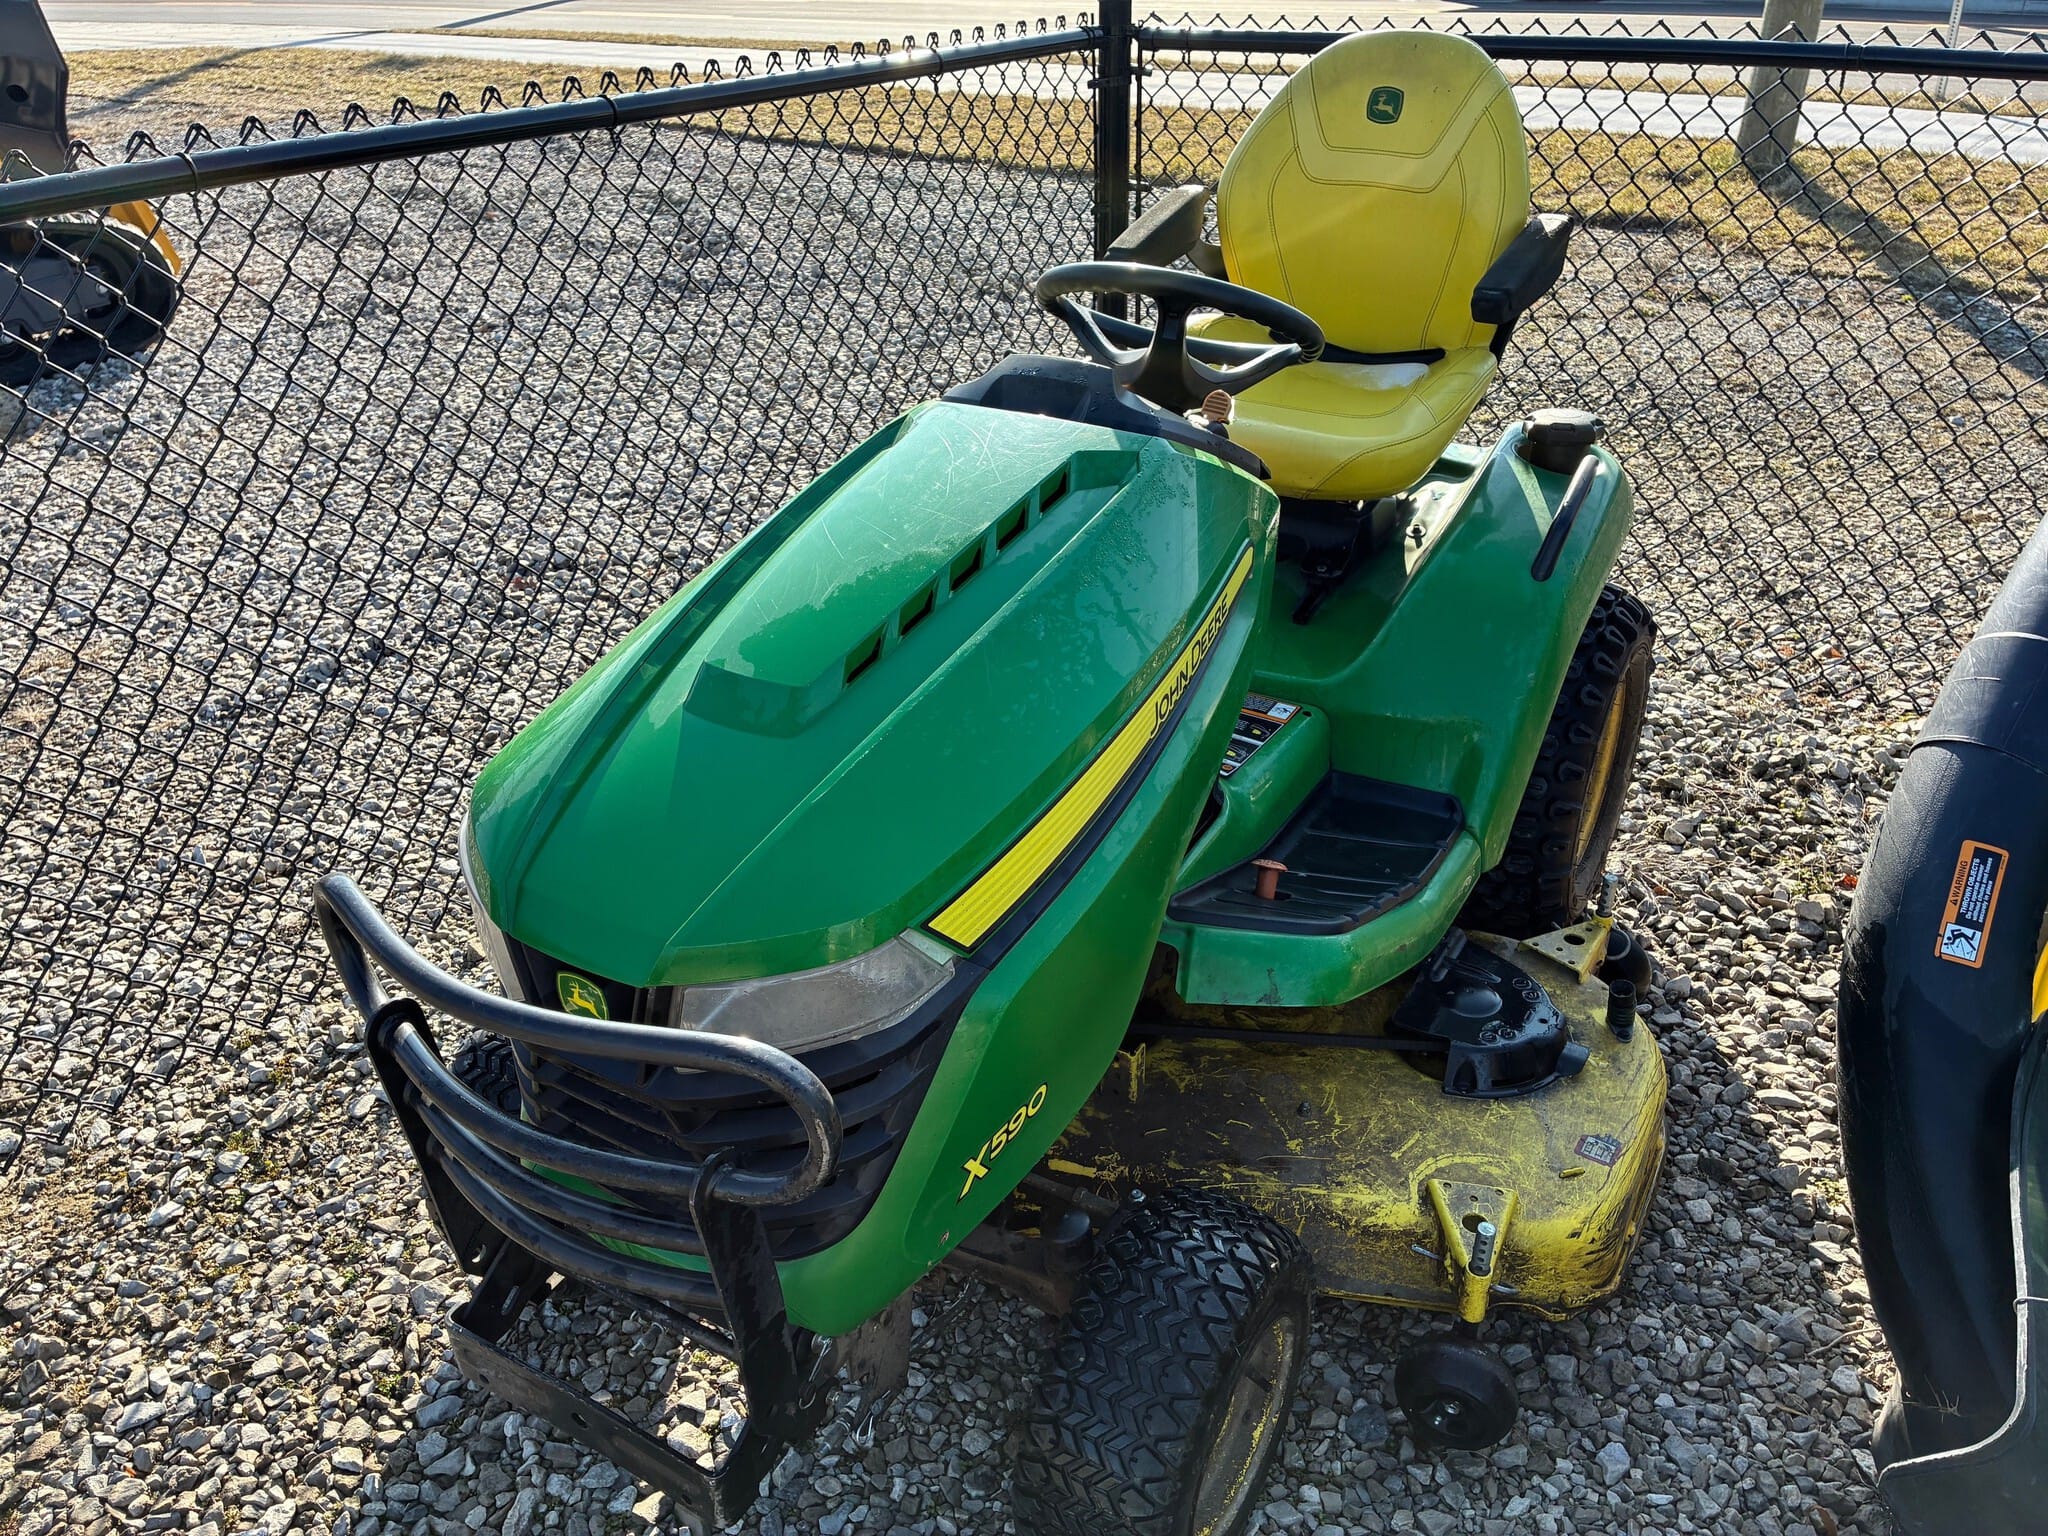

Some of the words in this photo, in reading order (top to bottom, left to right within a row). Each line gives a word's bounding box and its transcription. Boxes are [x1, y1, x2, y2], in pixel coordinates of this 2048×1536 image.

[1150, 661, 1190, 739] JOHN
[1190, 593, 1230, 673] DEERE
[1952, 861, 1968, 898] WARNING
[1960, 887, 1973, 913] THROWN
[1968, 858, 1980, 886] OBJECTS
[957, 1082, 1047, 1202] X590
